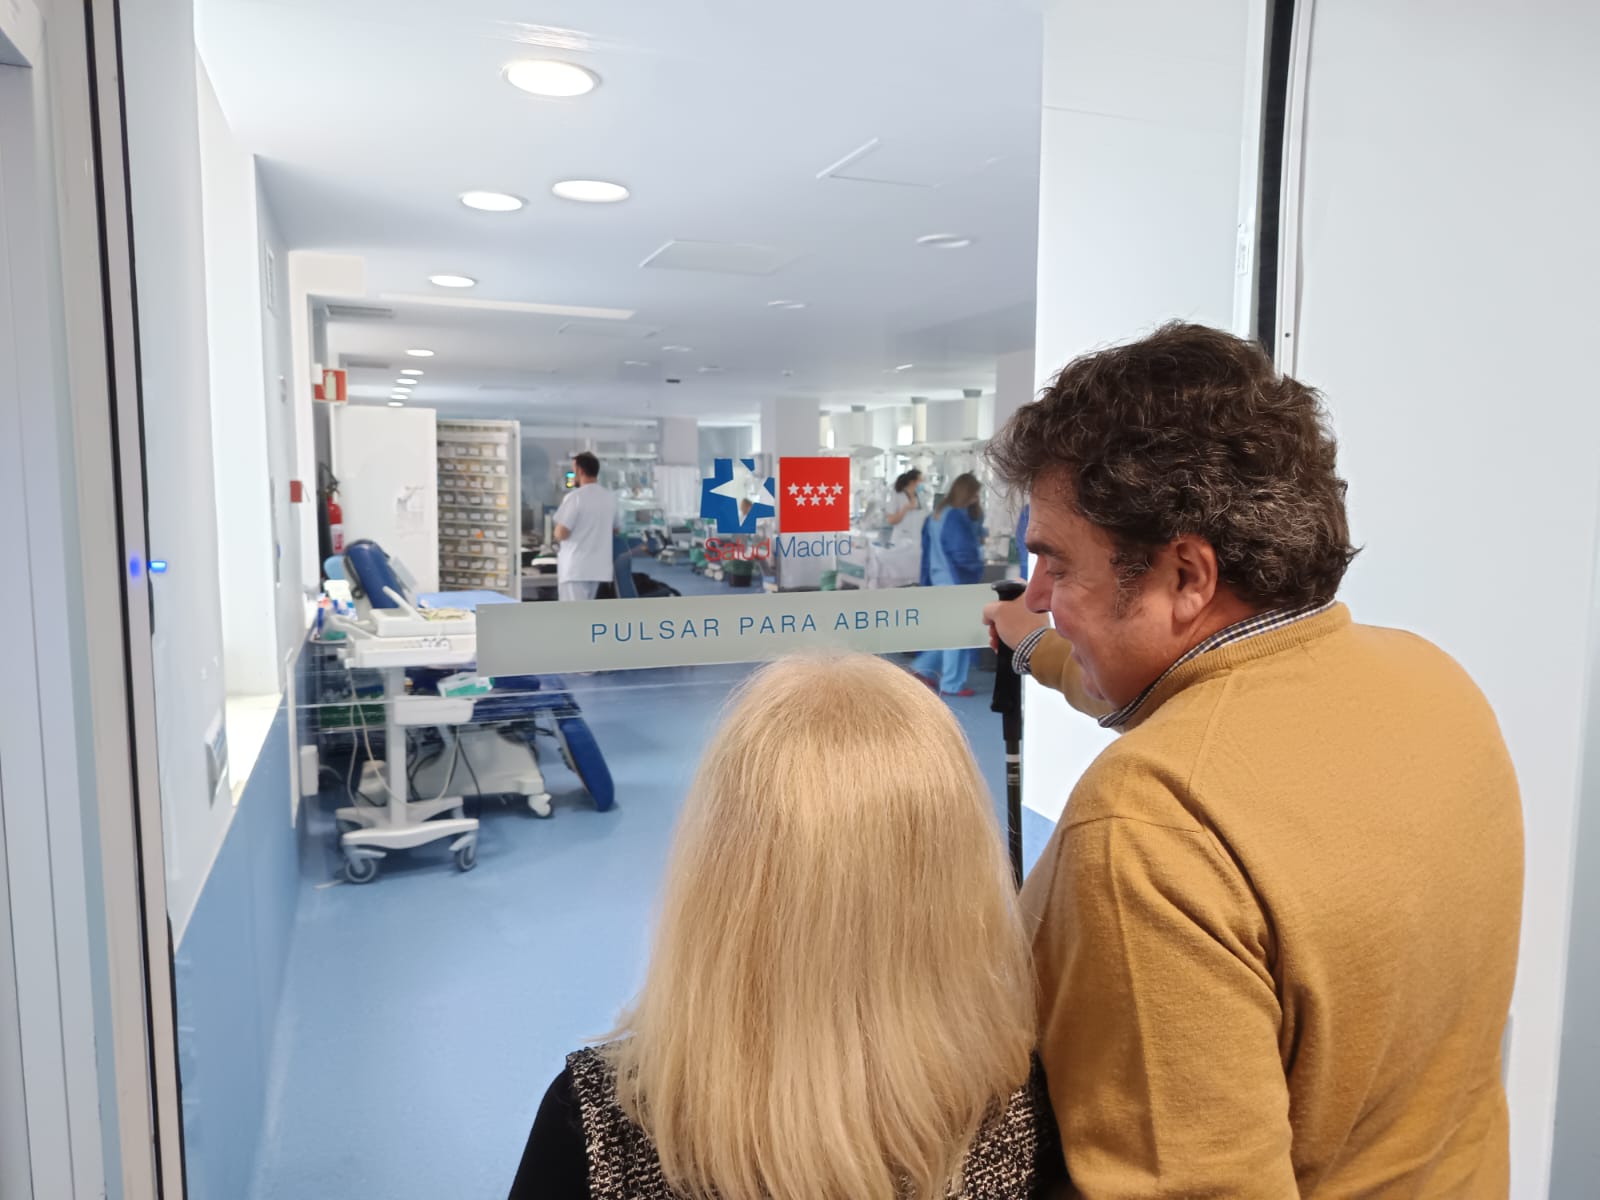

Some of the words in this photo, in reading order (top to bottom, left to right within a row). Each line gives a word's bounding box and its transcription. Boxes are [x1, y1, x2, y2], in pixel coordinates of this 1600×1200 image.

[591, 618, 720, 643] PULSAR
[739, 613, 818, 635] PARA
[834, 607, 921, 631] ABRIR
